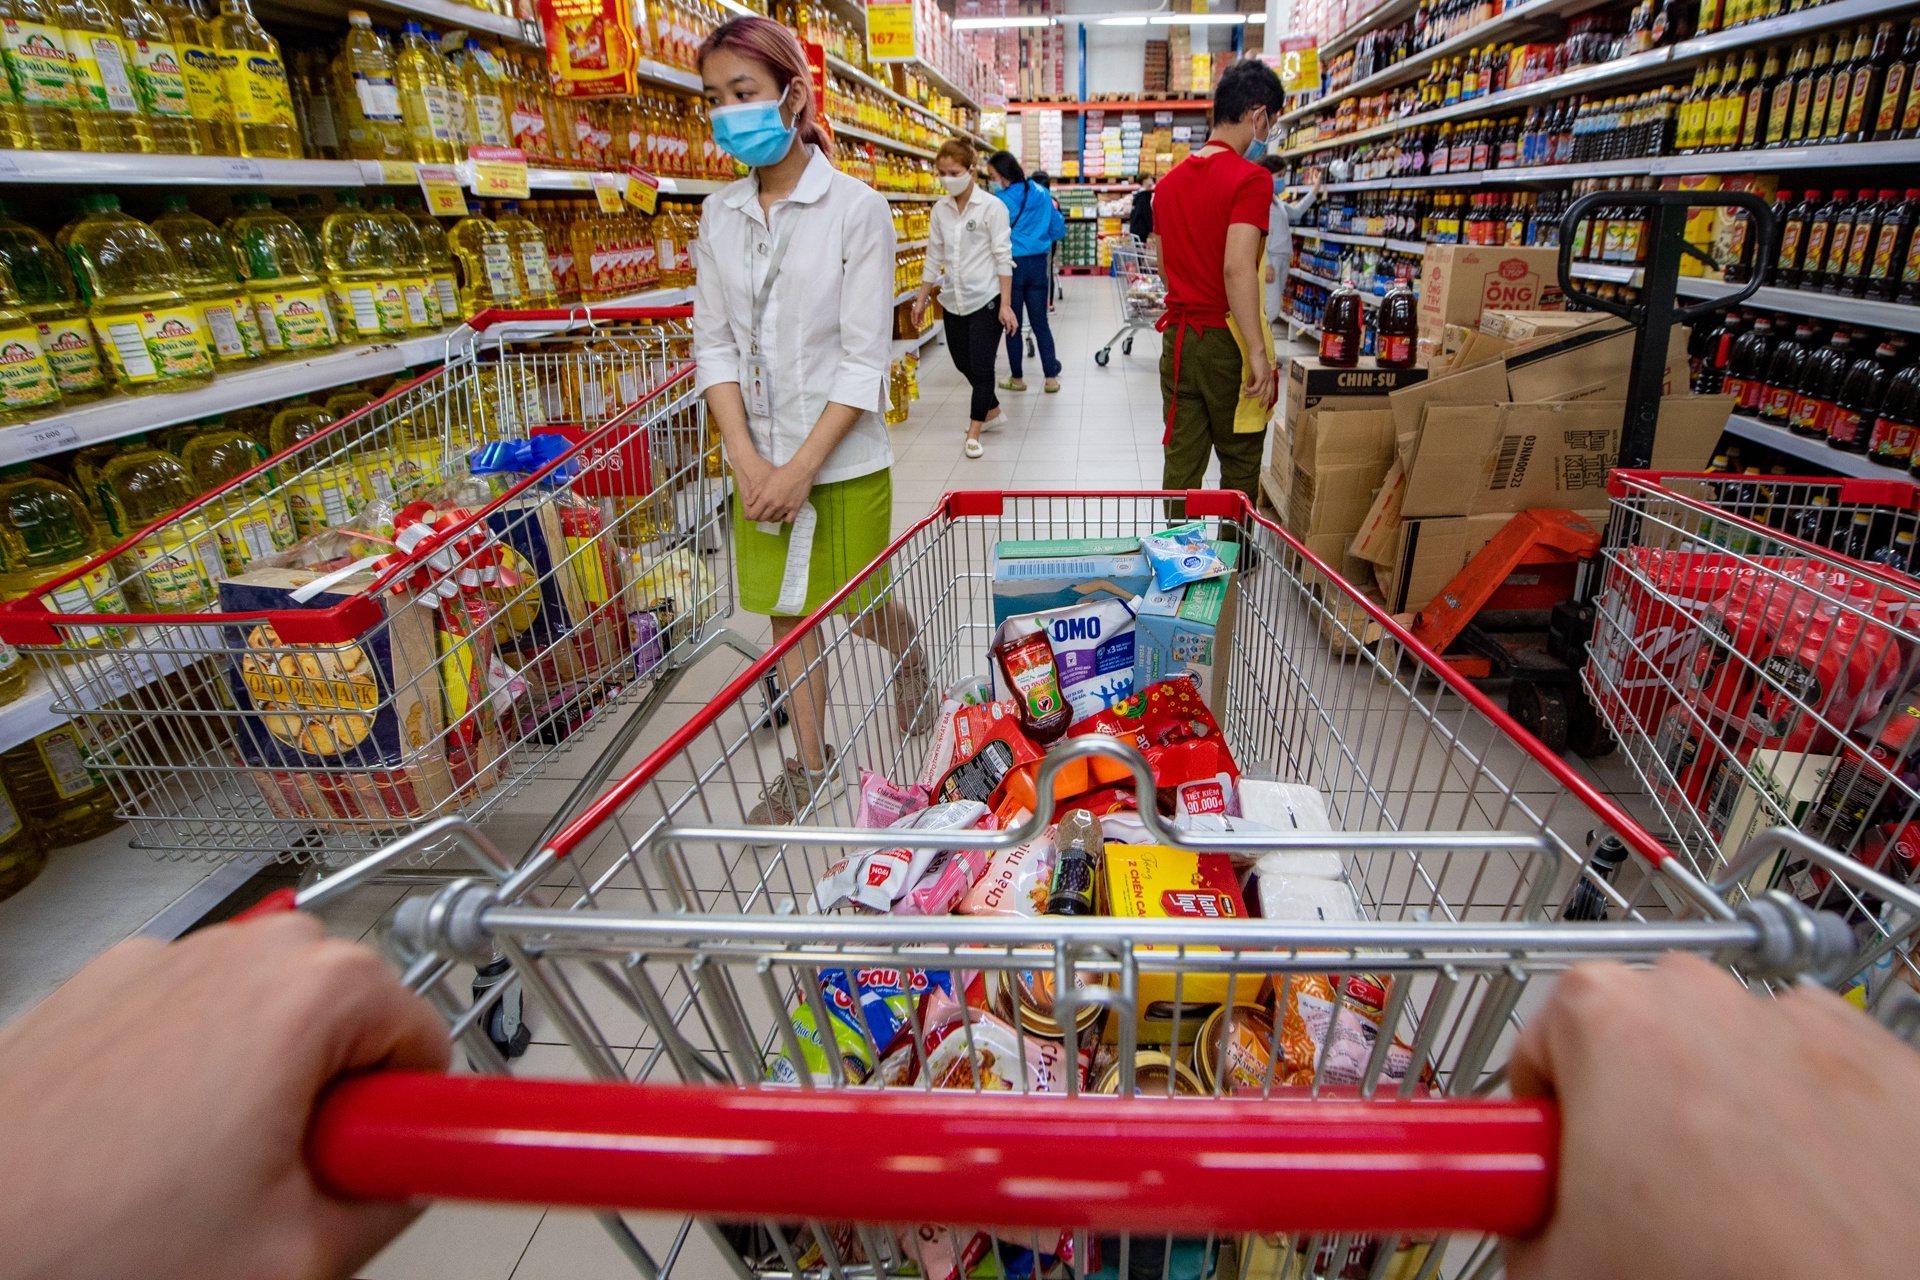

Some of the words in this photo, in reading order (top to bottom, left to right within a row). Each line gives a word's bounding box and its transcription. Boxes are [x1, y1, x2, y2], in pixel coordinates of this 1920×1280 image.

[871, 32, 894, 45] 167
[19, 44, 66, 60] MEIZAN
[283, 307, 315, 317] MEIZAN
[156, 326, 193, 339] MEIZAN
[51, 340, 89, 352] MEIZAN
[1337, 372, 1397, 387] CHIN-SU
[1510, 435, 1537, 488] 03NM00523
[1054, 616, 1101, 642] OMO
[249, 675, 283, 695] OLD
[288, 679, 375, 705] DENMARK
[1186, 790, 1201, 801] TIẾT
[1201, 787, 1220, 799] KIỆM
[984, 867, 1013, 908] Cháo
[1130, 869, 1144, 899] CHÉN
